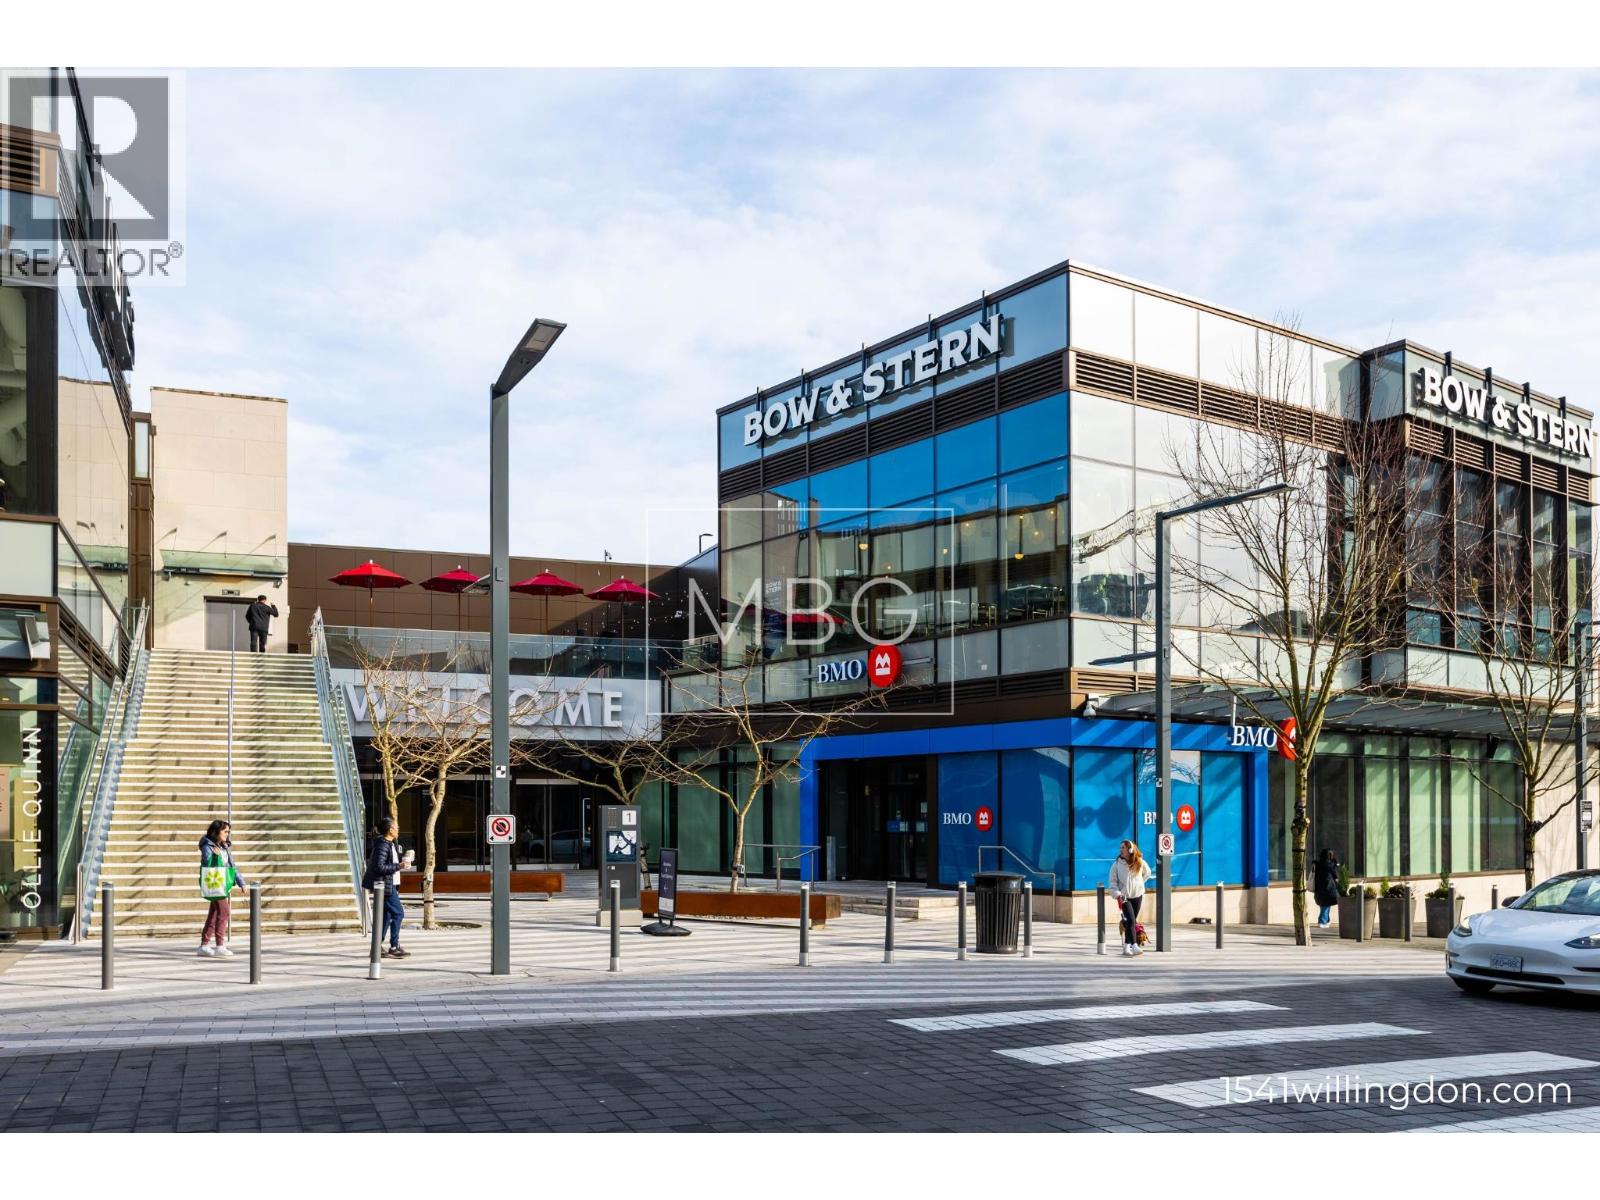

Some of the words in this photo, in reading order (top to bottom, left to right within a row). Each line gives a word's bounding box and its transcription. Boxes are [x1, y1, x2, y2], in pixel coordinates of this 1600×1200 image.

[744, 386, 820, 446] BOW
[826, 379, 852, 414] &
[862, 313, 1003, 401] STERN
[1423, 366, 1488, 422] BOW
[1492, 396, 1511, 430] &
[1517, 402, 1593, 458] STERN
[817, 659, 863, 684] BMO
[1231, 725, 1278, 748] BMO
[22, 727, 42, 817] QUINN
[626, 812, 632, 823] 1
[943, 812, 972, 825] BMO
[22, 829, 42, 909] OLLIE
